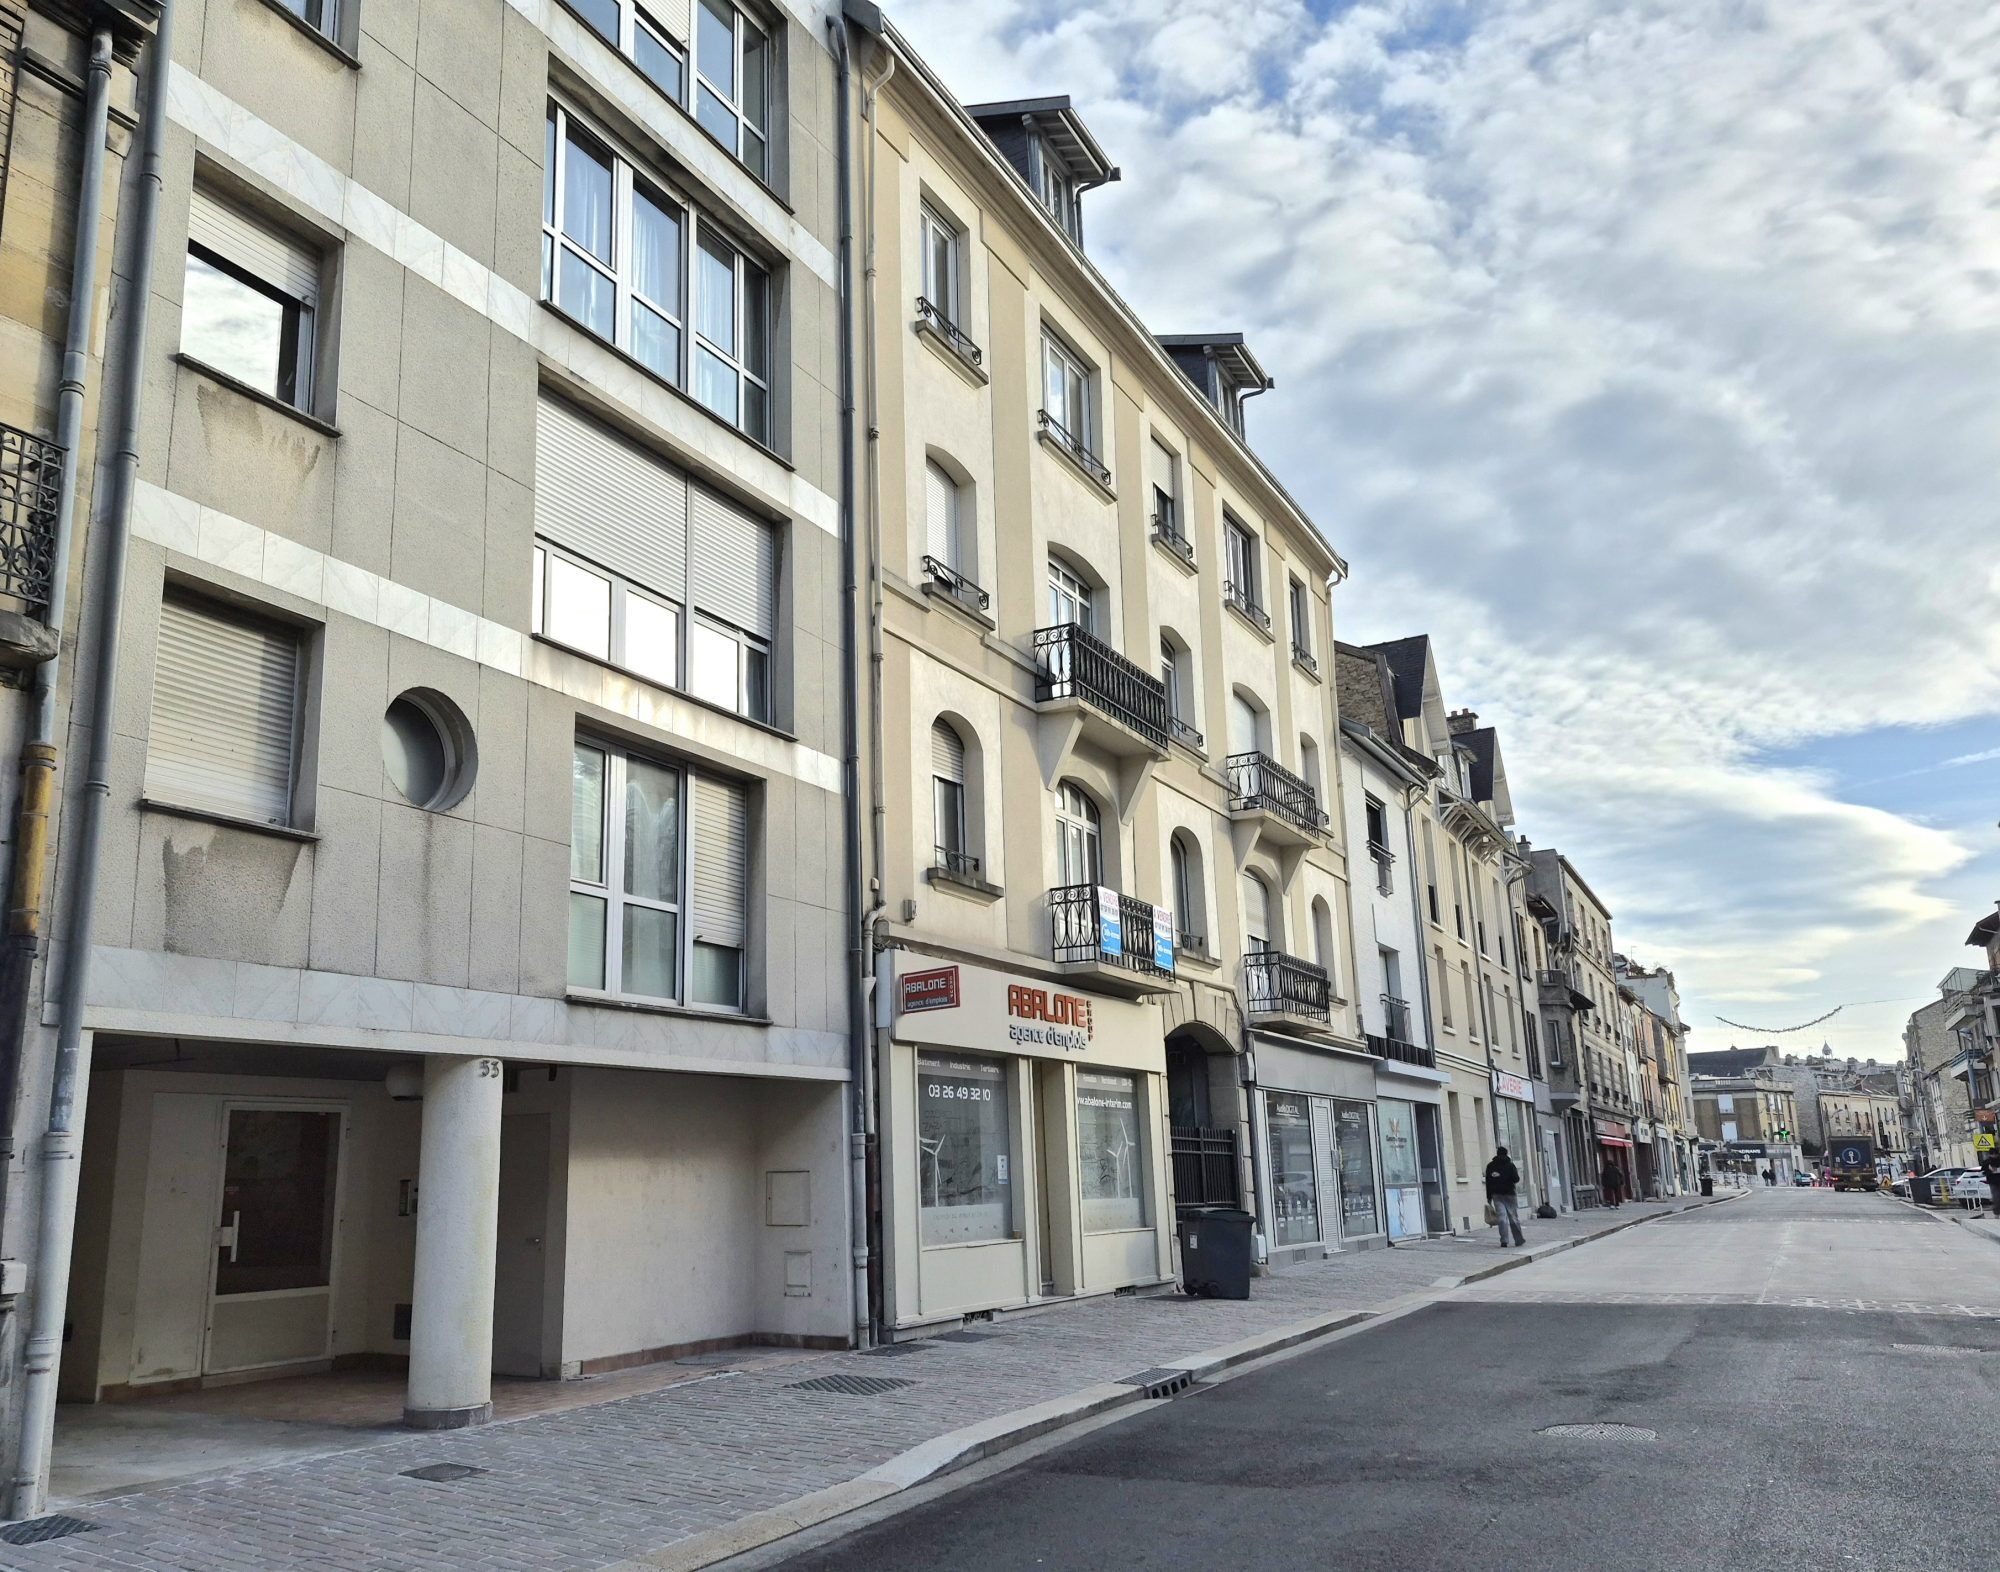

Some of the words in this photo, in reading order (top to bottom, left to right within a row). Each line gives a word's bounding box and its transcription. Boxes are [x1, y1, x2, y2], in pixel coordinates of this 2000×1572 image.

[905, 977, 947, 994] ABALONE
[1008, 984, 1087, 1028] ABALONE
[1009, 1023, 1044, 1046] agence
[1046, 1026, 1087, 1052] d'emplois
[928, 1083, 940, 1098] 03
[943, 1085, 954, 1099] 26
[956, 1086, 968, 1100] 49
[970, 1087, 981, 1101] 32
[982, 1088, 991, 1101] 10
